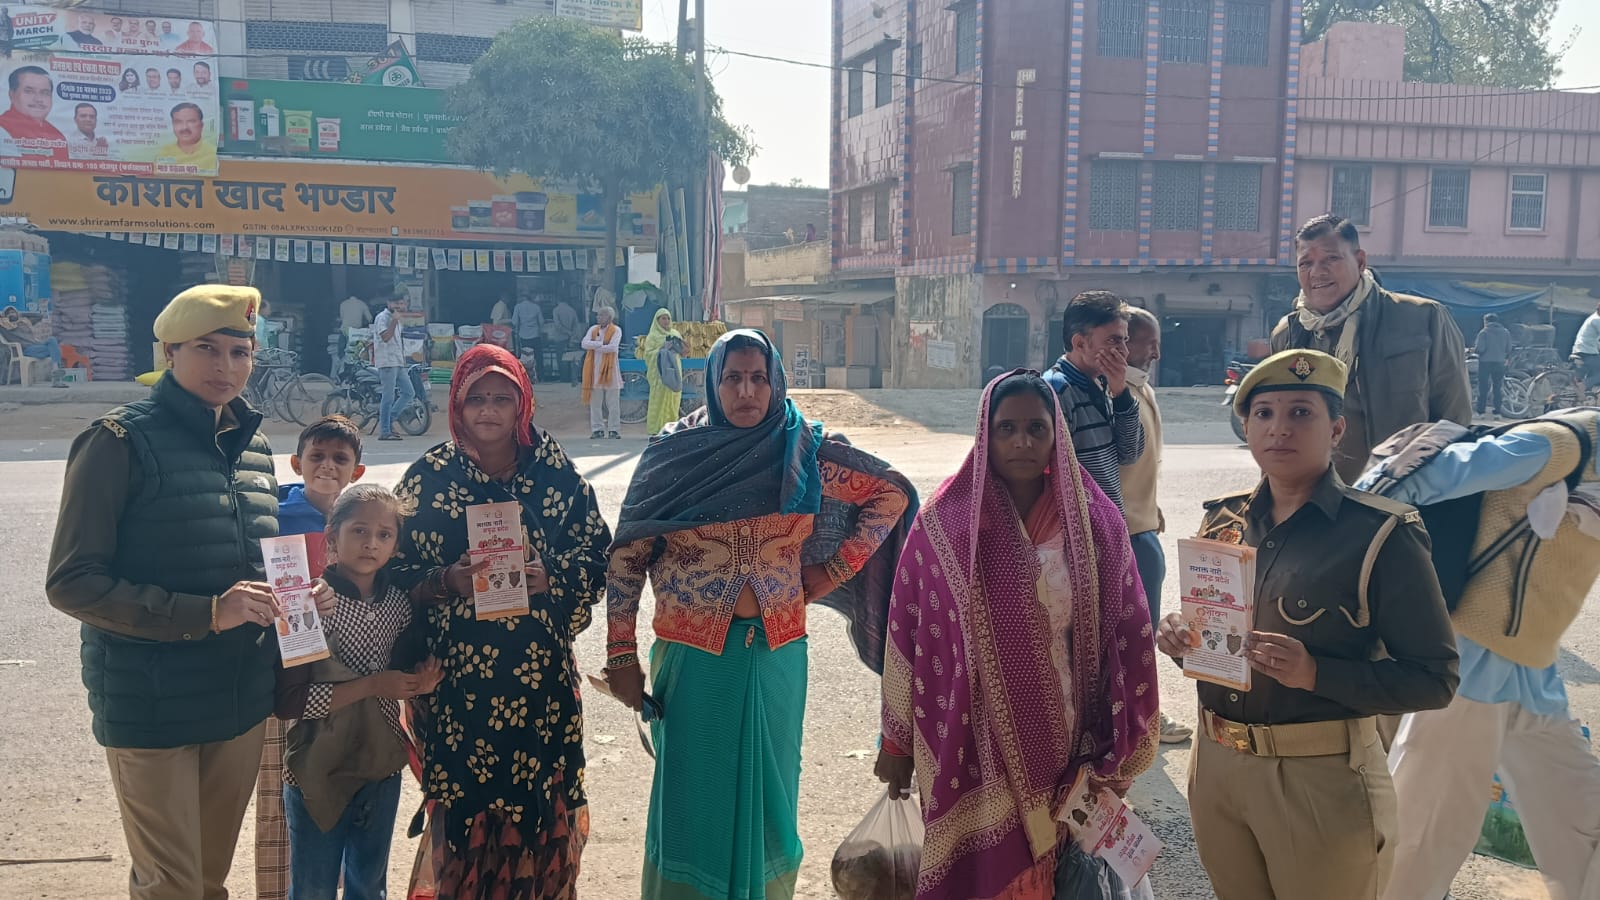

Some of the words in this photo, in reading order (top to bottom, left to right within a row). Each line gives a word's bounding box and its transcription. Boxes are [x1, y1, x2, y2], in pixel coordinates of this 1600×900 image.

[15, 15, 53, 26] UNITY
[15, 26, 54, 36] MARCH
[213, 180, 286, 212] खाद
[294, 182, 397, 214] भण्डार
[48, 216, 215, 229] www.shriramfarmsolutions.com
